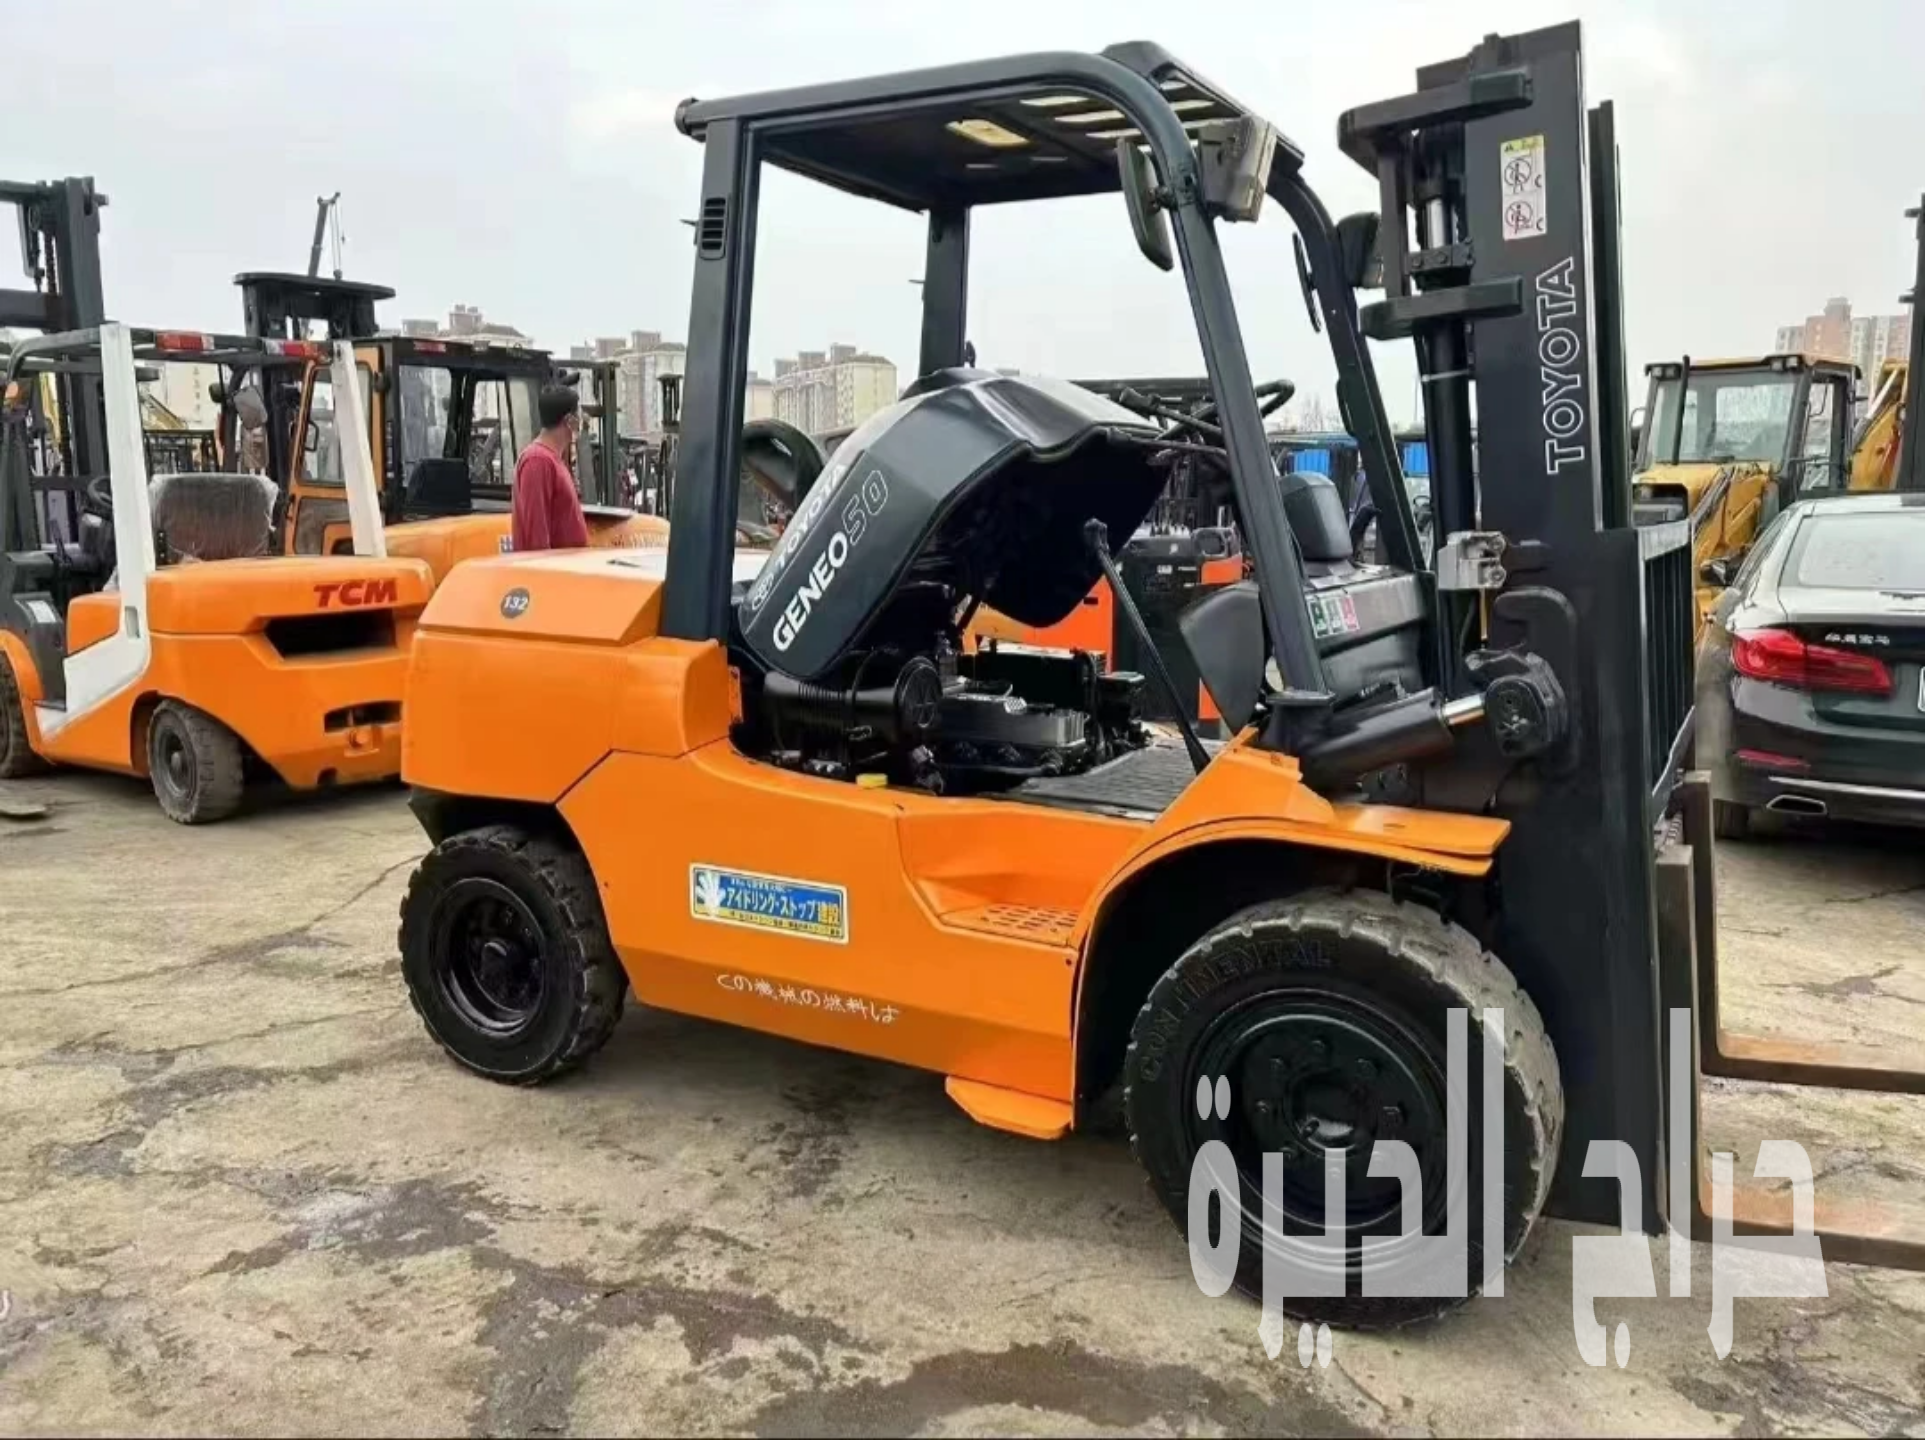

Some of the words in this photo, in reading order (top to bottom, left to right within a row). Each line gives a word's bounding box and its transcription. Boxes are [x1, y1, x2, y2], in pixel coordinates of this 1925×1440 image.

[1536, 256, 1585, 475] TOYOTA
[775, 464, 848, 570] TOYOTA
[313, 578, 398, 608] TCM
[504, 594, 528, 610] 132
